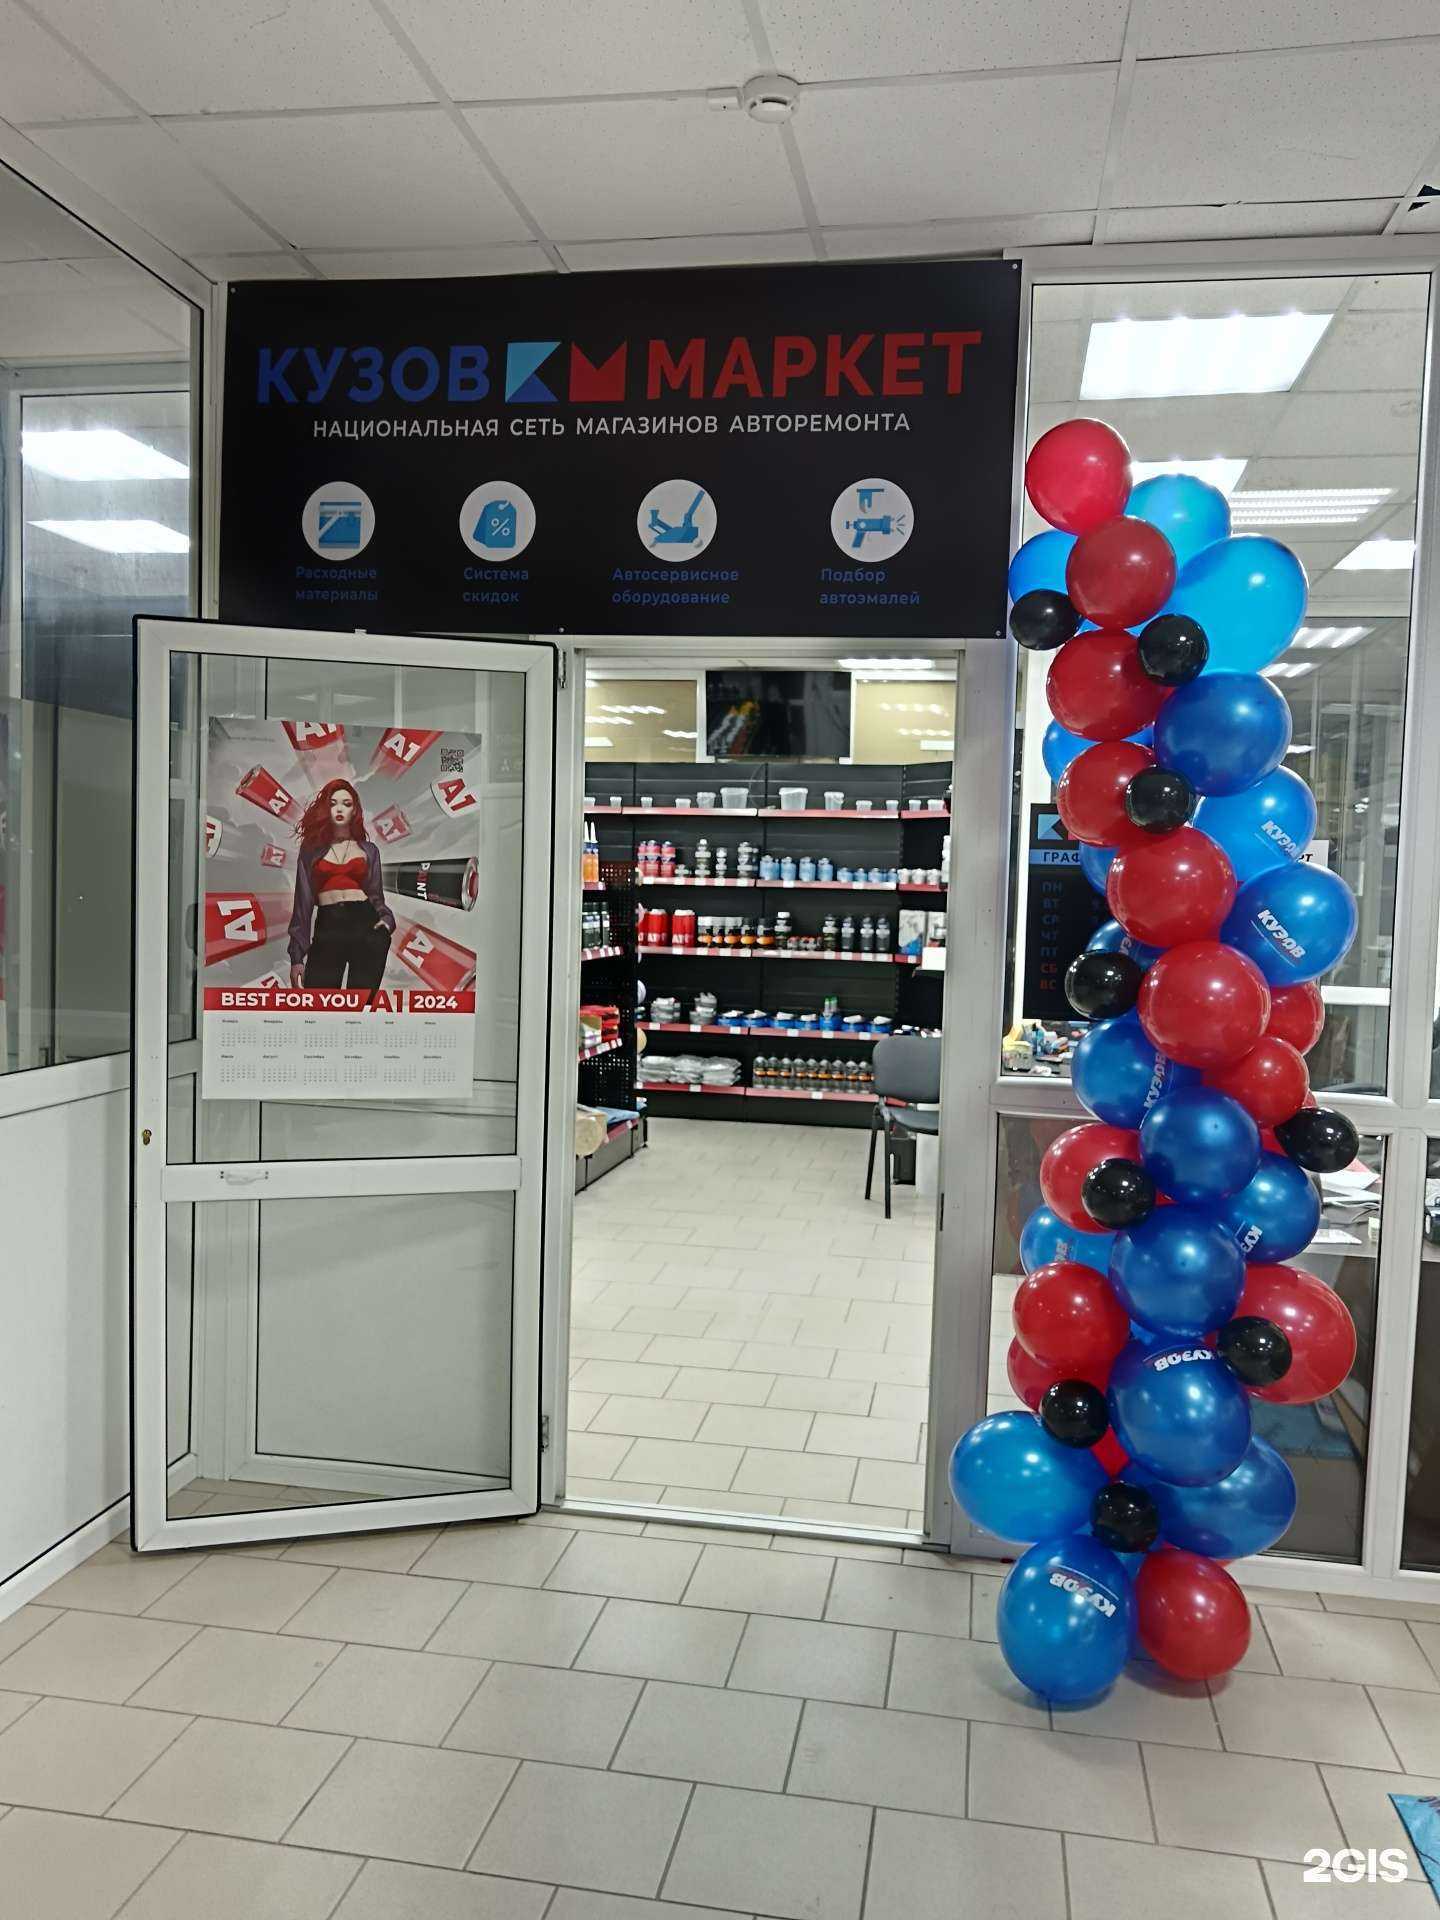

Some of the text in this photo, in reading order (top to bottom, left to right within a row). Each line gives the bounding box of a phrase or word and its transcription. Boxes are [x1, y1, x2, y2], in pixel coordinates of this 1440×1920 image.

[257, 345, 490, 403] КУЗОВ
[647, 330, 983, 400] МАРКЕТ
[313, 412, 911, 440] НАЦИОНАЛЬНАЯ СЕТЬ МАГАЗИНОВ АВТОРЕМОНТА
[295, 565, 378, 580] Расходные
[463, 567, 529, 581] Система
[611, 566, 740, 583] Автосервисное
[820, 566, 887, 583] Подбор
[295, 587, 379, 603] материалы
[462, 591, 520, 604] скидок
[611, 589, 730, 606] оборудование
[819, 588, 921, 606] автоэмалей
[383, 733, 421, 762] A1
[268, 789, 289, 814] A1
[437, 778, 476, 812] A1
[217, 900, 258, 942] A1
[1257, 909, 1306, 959] КУЗОВ
[401, 929, 435, 969] A1
[221, 990, 459, 1013] BEST FOR YOU A1 2024
[1049, 1573, 1117, 1618] КУЗОВ
